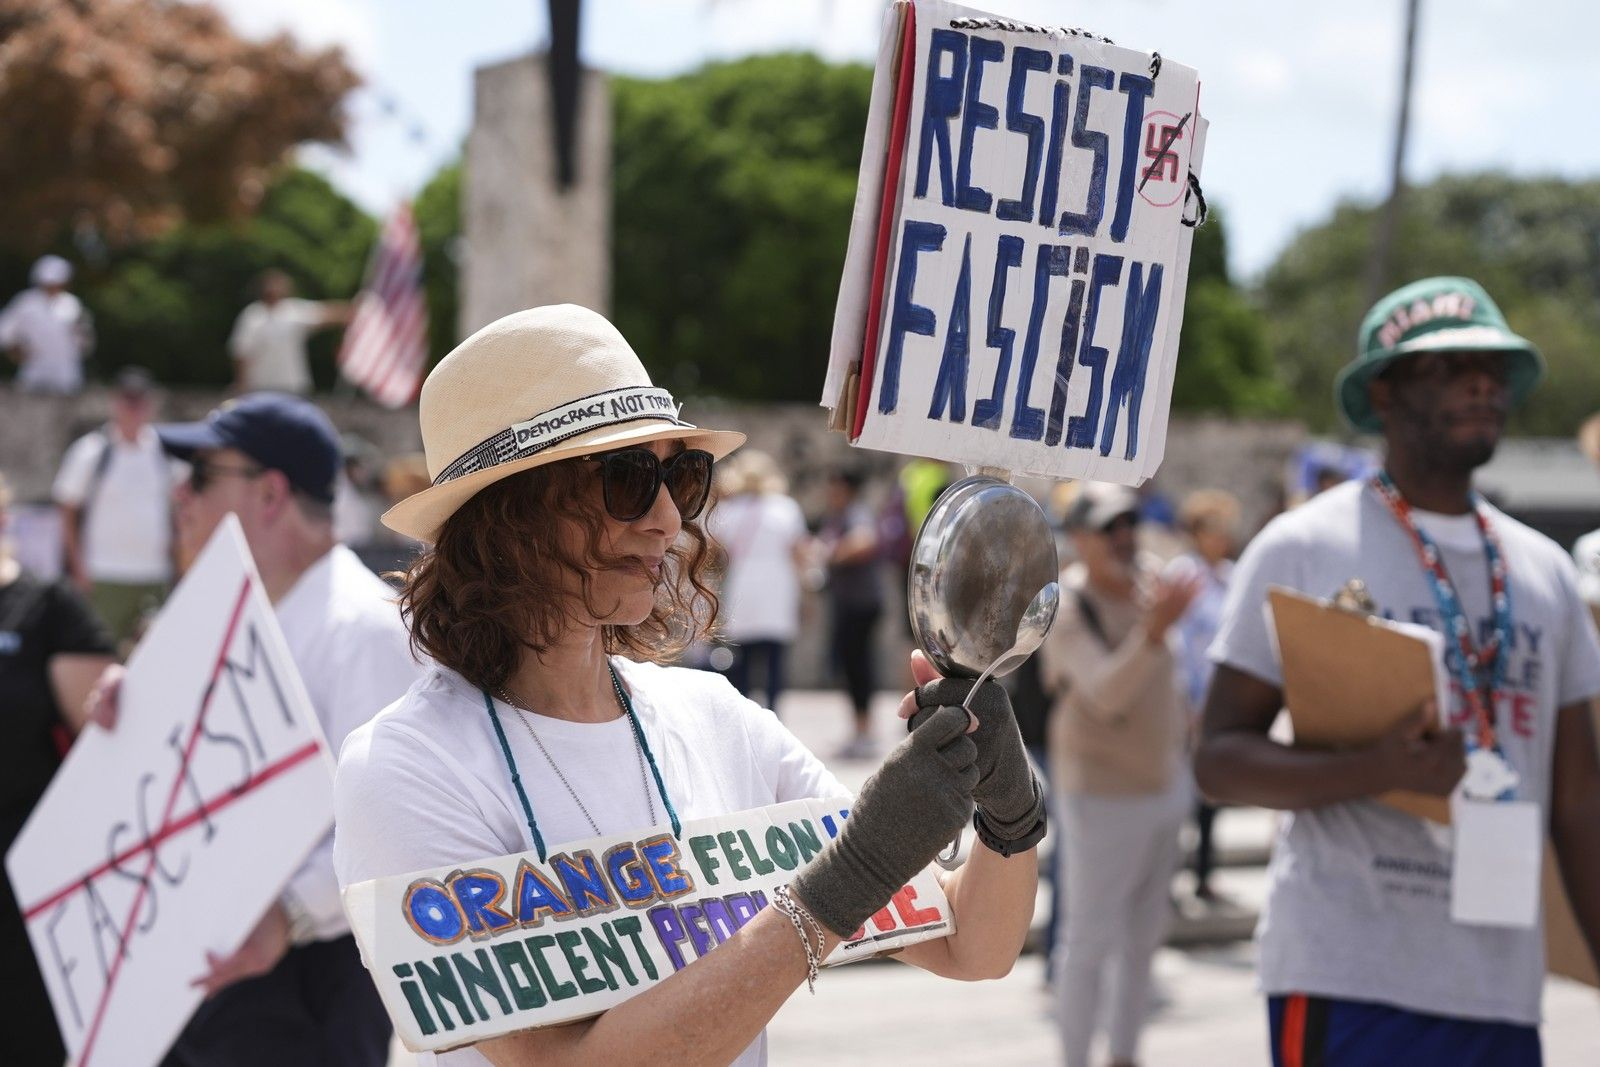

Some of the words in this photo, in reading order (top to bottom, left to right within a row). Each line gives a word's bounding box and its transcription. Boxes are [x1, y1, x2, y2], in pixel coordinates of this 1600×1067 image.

[516, 401, 605, 444] DEMOCRACY
[610, 394, 645, 419] NOT
[46, 622, 295, 1030] FASCISM
[401, 832, 698, 947] ORANGE
[688, 818, 823, 886] FELON
